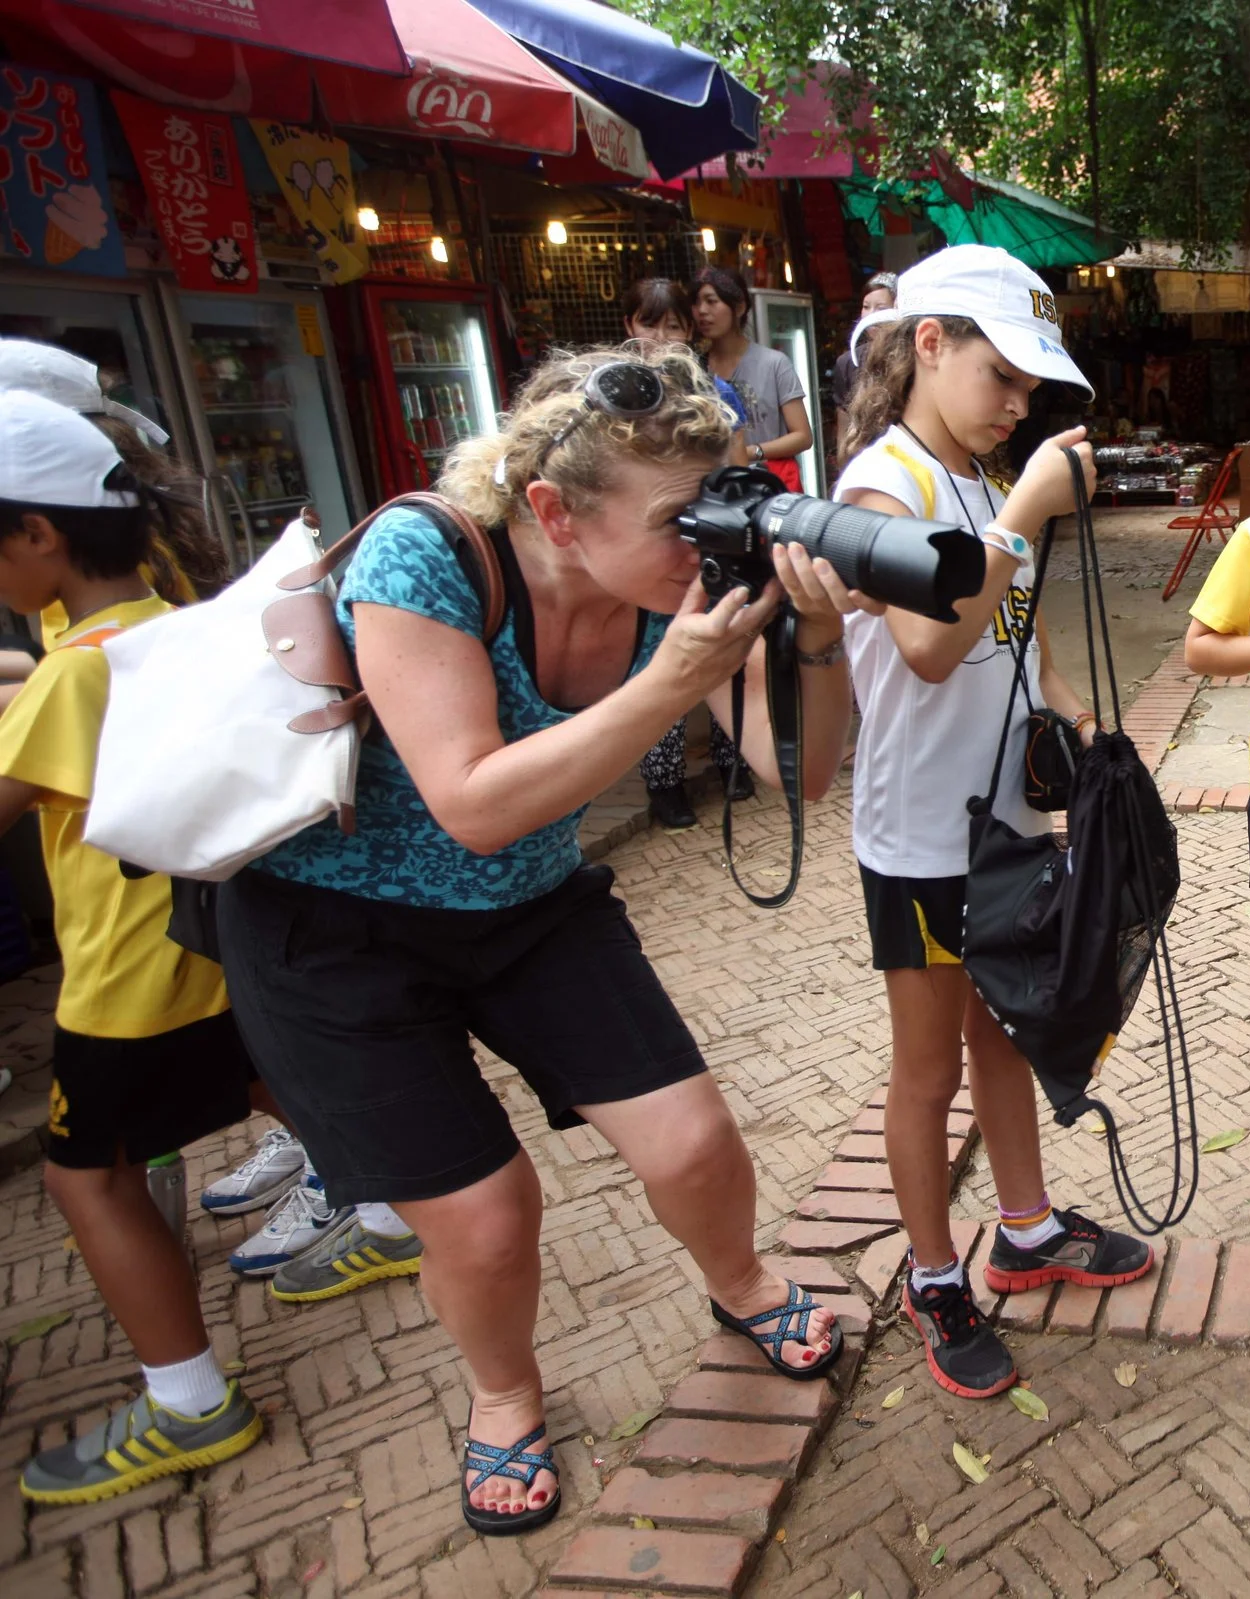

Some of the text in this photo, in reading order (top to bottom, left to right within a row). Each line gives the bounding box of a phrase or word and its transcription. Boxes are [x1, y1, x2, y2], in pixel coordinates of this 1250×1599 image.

[2, 67, 66, 198] ソフト
[163, 113, 213, 256] ありがとう
